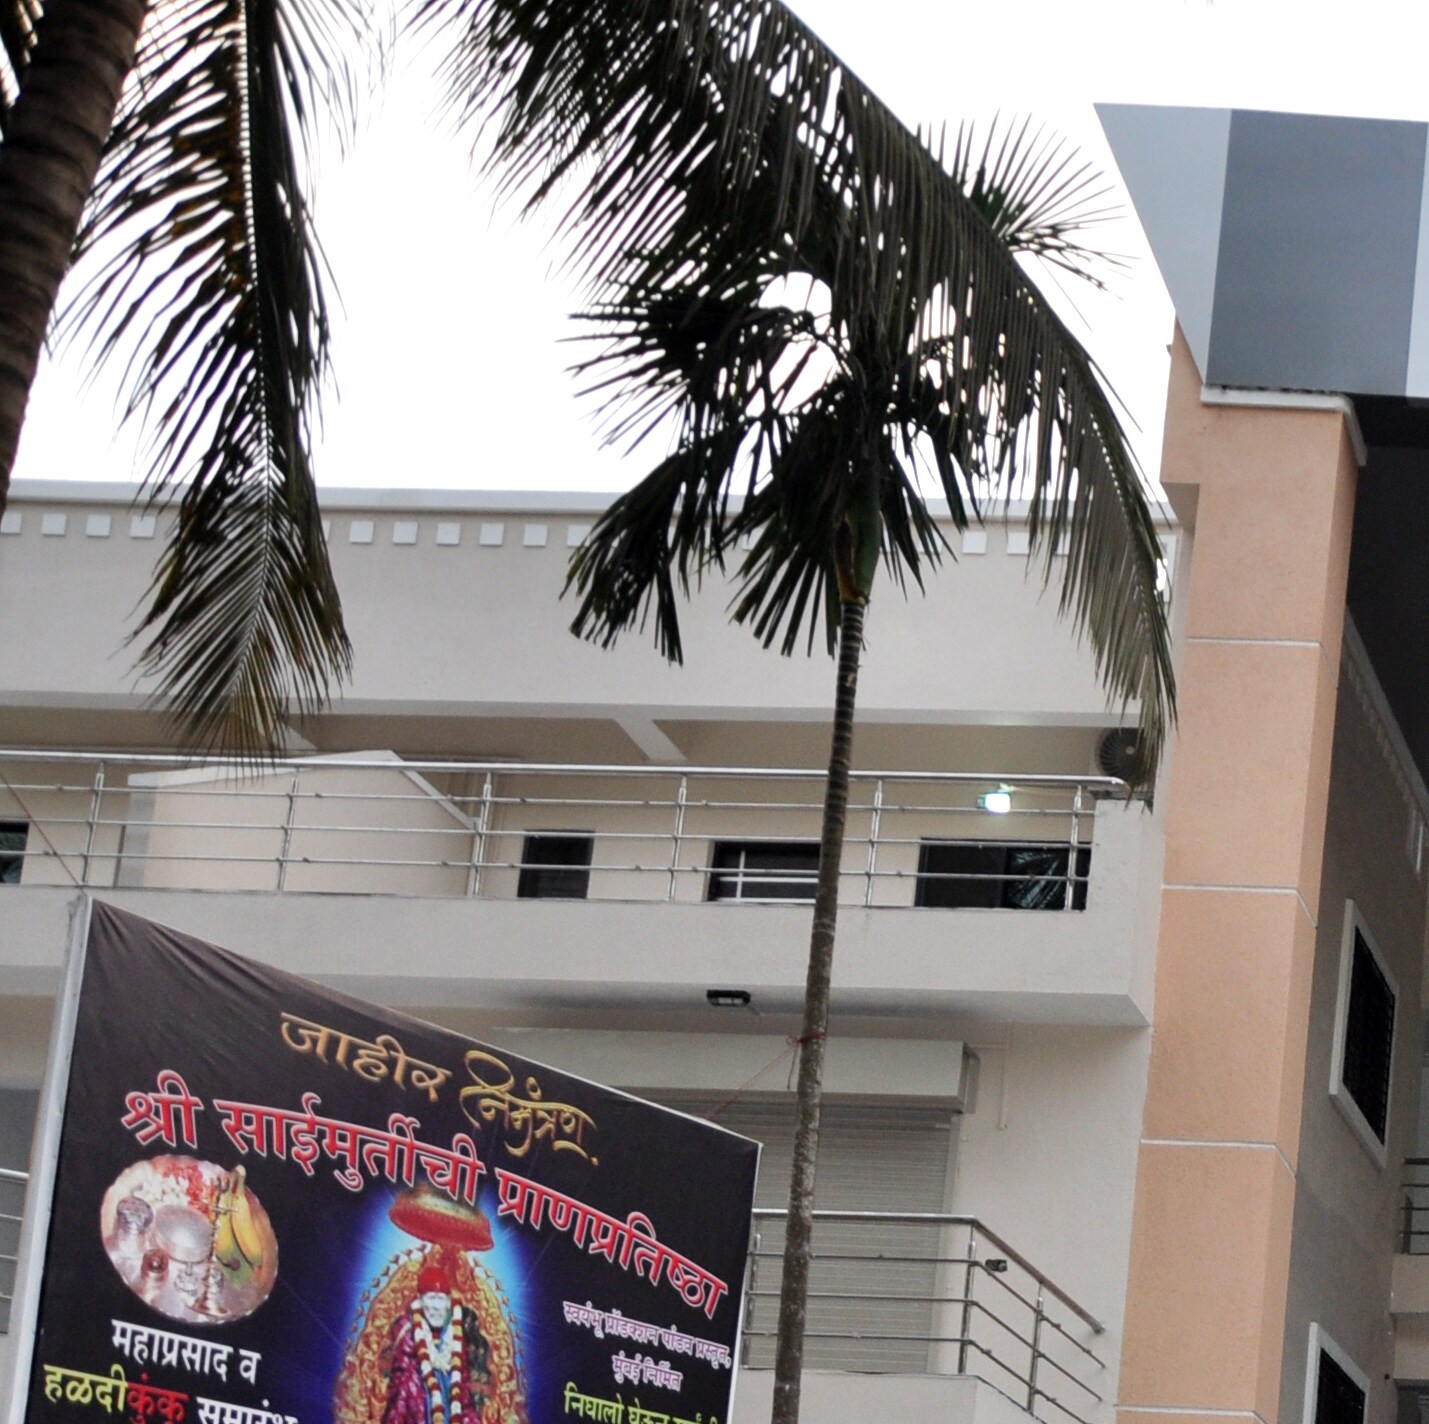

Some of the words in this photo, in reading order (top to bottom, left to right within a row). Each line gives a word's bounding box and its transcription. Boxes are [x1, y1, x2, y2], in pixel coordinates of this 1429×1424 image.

[280, 1011, 452, 1101] जाहीर
[121, 1069, 204, 1149] श्री
[213, 1092, 487, 1206] साईमुर्तीची
[494, 1167, 729, 1319] प्राणप्रतिष्ठा
[111, 1319, 234, 1382] महाप्रसाद
[239, 1349, 261, 1384] व
